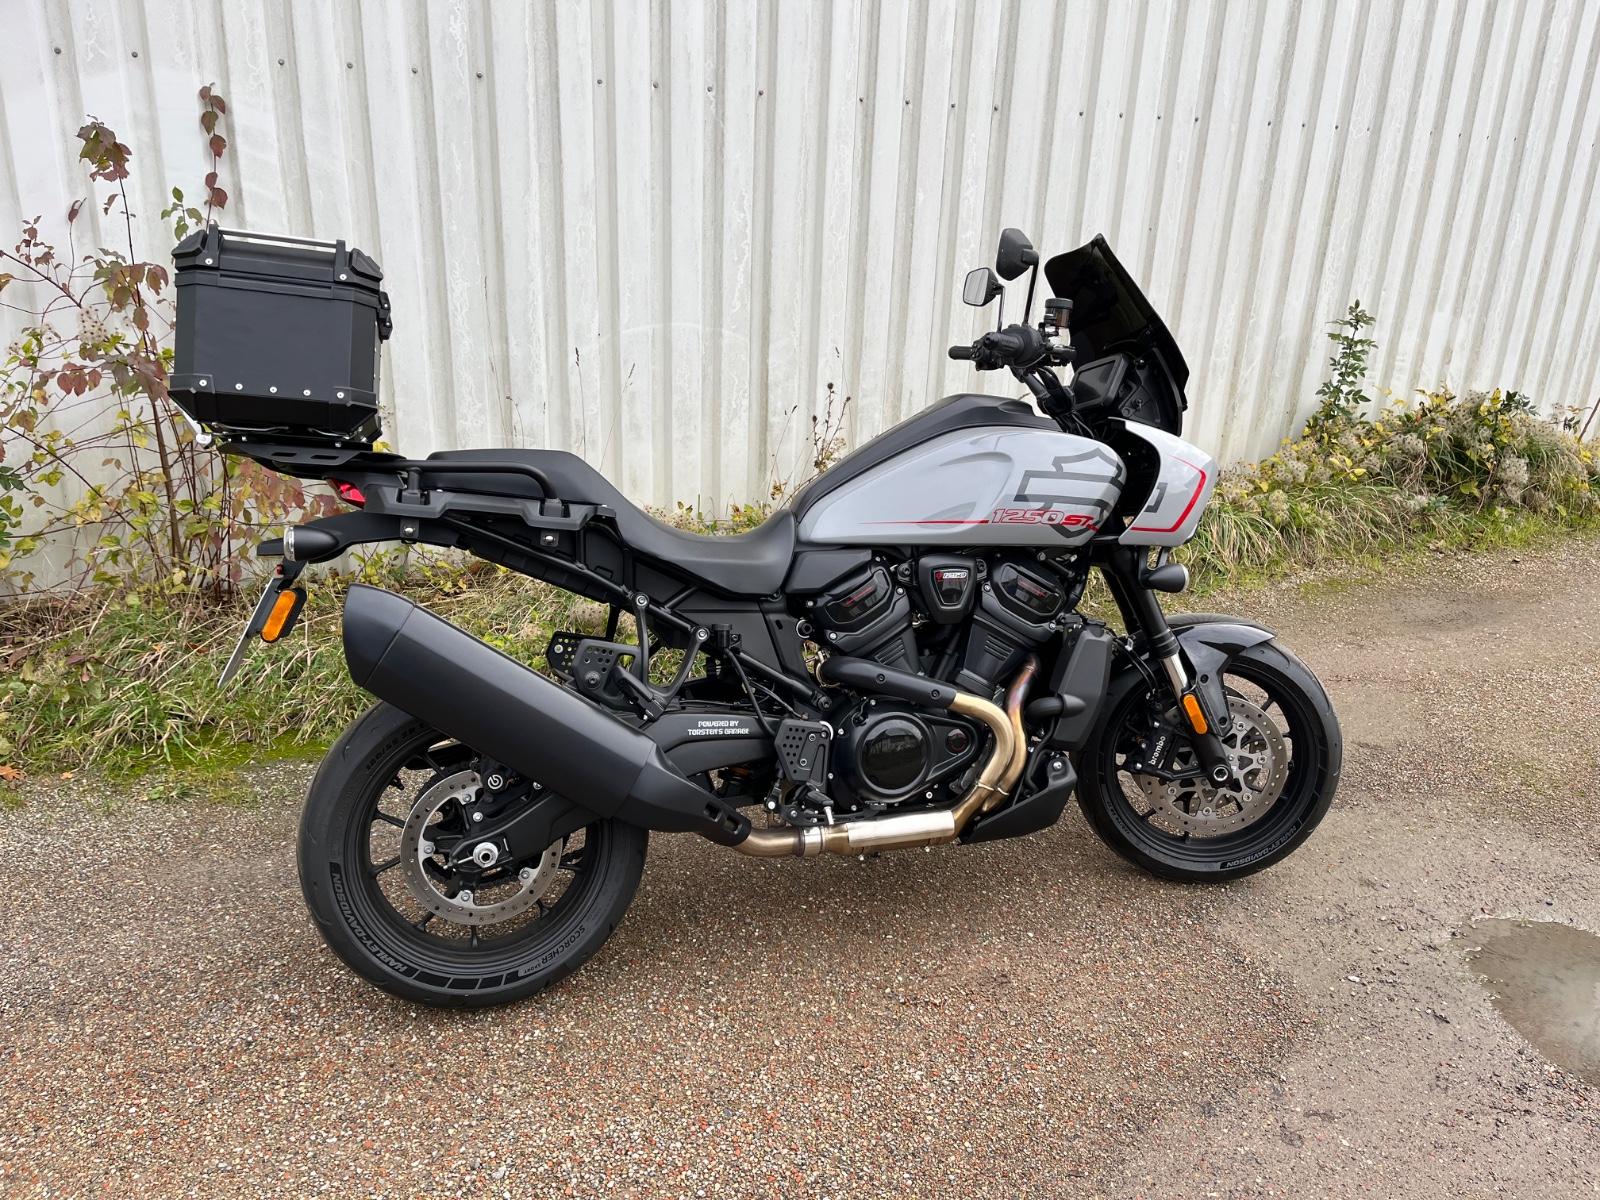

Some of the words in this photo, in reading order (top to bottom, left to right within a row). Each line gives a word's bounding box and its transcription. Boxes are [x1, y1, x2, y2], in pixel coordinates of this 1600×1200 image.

[724, 727, 750, 735] GARAGE
[1149, 735, 1166, 766] brembo
[1226, 824, 1298, 868] HARLEY-DAVIDSON
[332, 872, 408, 974] HARLEY-DAVIDSON
[541, 924, 587, 966] SCORCHER
